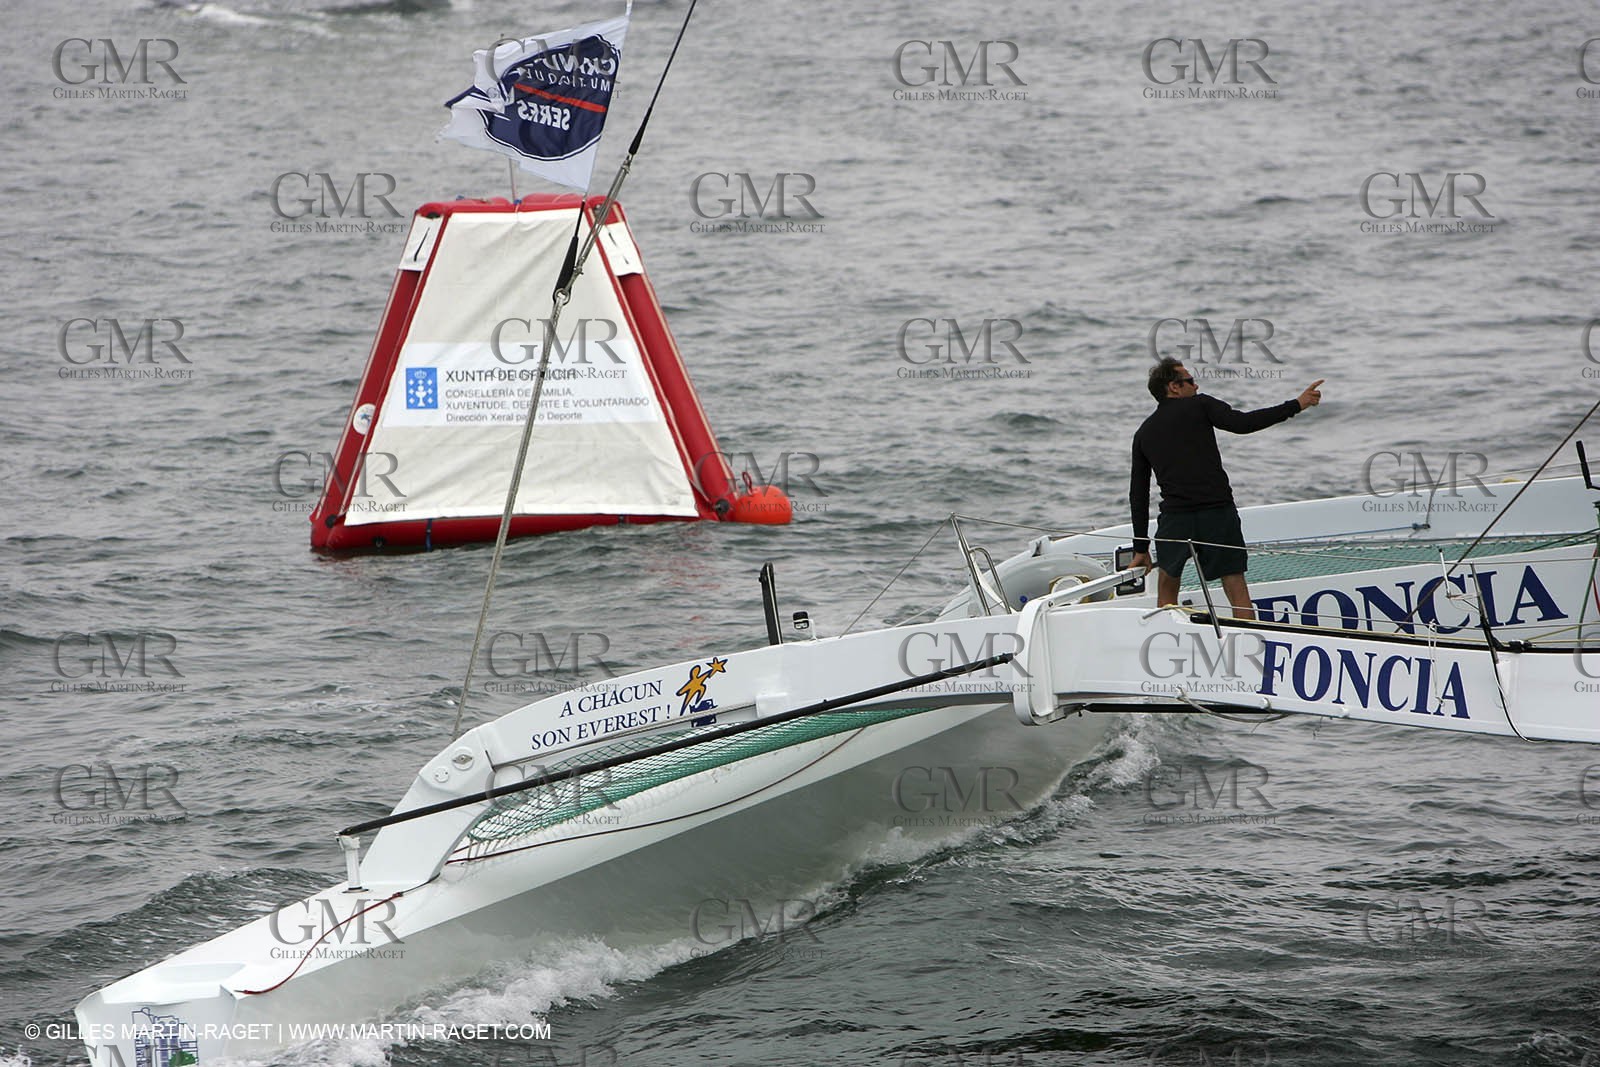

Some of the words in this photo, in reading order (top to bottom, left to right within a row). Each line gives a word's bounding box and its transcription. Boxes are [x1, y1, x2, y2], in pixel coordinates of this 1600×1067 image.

[446, 369, 494, 382] XUNTA
[498, 369, 515, 382] DE
[513, 400, 560, 410] DEPRTE
[573, 398, 649, 408] VOLUNTARIADO
[517, 388, 531, 398] DE
[535, 388, 575, 398] AMILIA,
[446, 413, 488, 423] Dirección
[491, 412, 514, 421] Xeral
[547, 411, 582, 422] Deporte
[1251, 565, 1568, 637] FONCIA
[1256, 639, 1471, 720] FONCIA
[560, 700, 574, 718] A
[578, 680, 663, 713] CHACUN
[532, 726, 571, 750] SON
[577, 705, 662, 740] EVEREST
